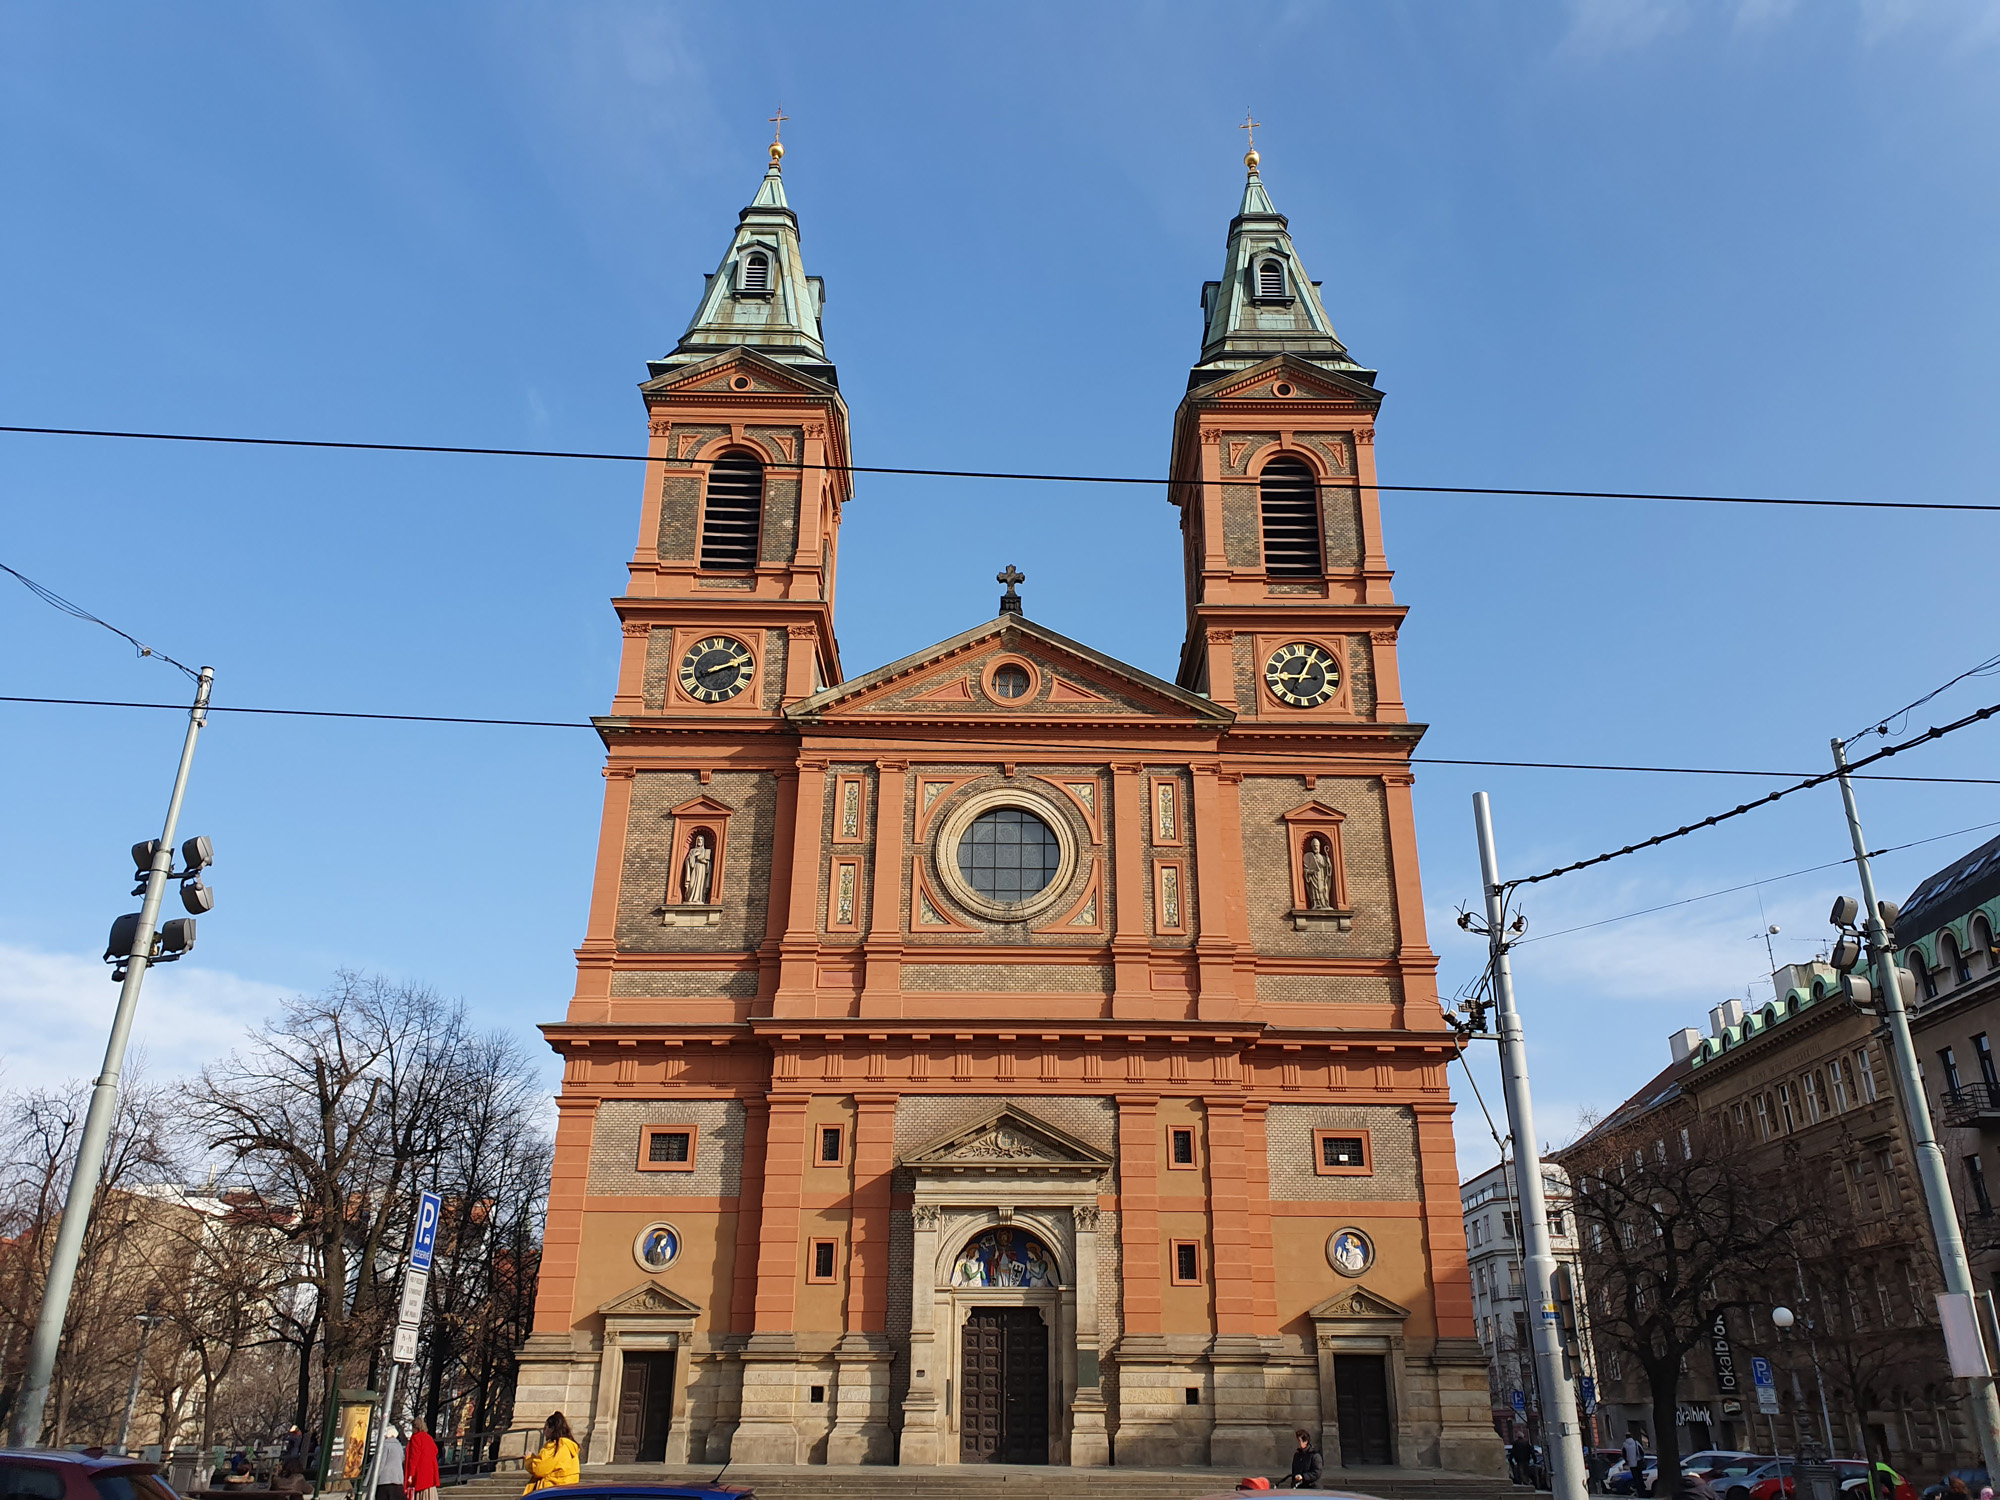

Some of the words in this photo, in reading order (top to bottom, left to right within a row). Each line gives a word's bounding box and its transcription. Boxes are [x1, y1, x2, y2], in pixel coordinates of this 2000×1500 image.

[419, 1201, 434, 1243] P
[1755, 1361, 1767, 1377] P
[1676, 1406, 1712, 1426] okalblok
